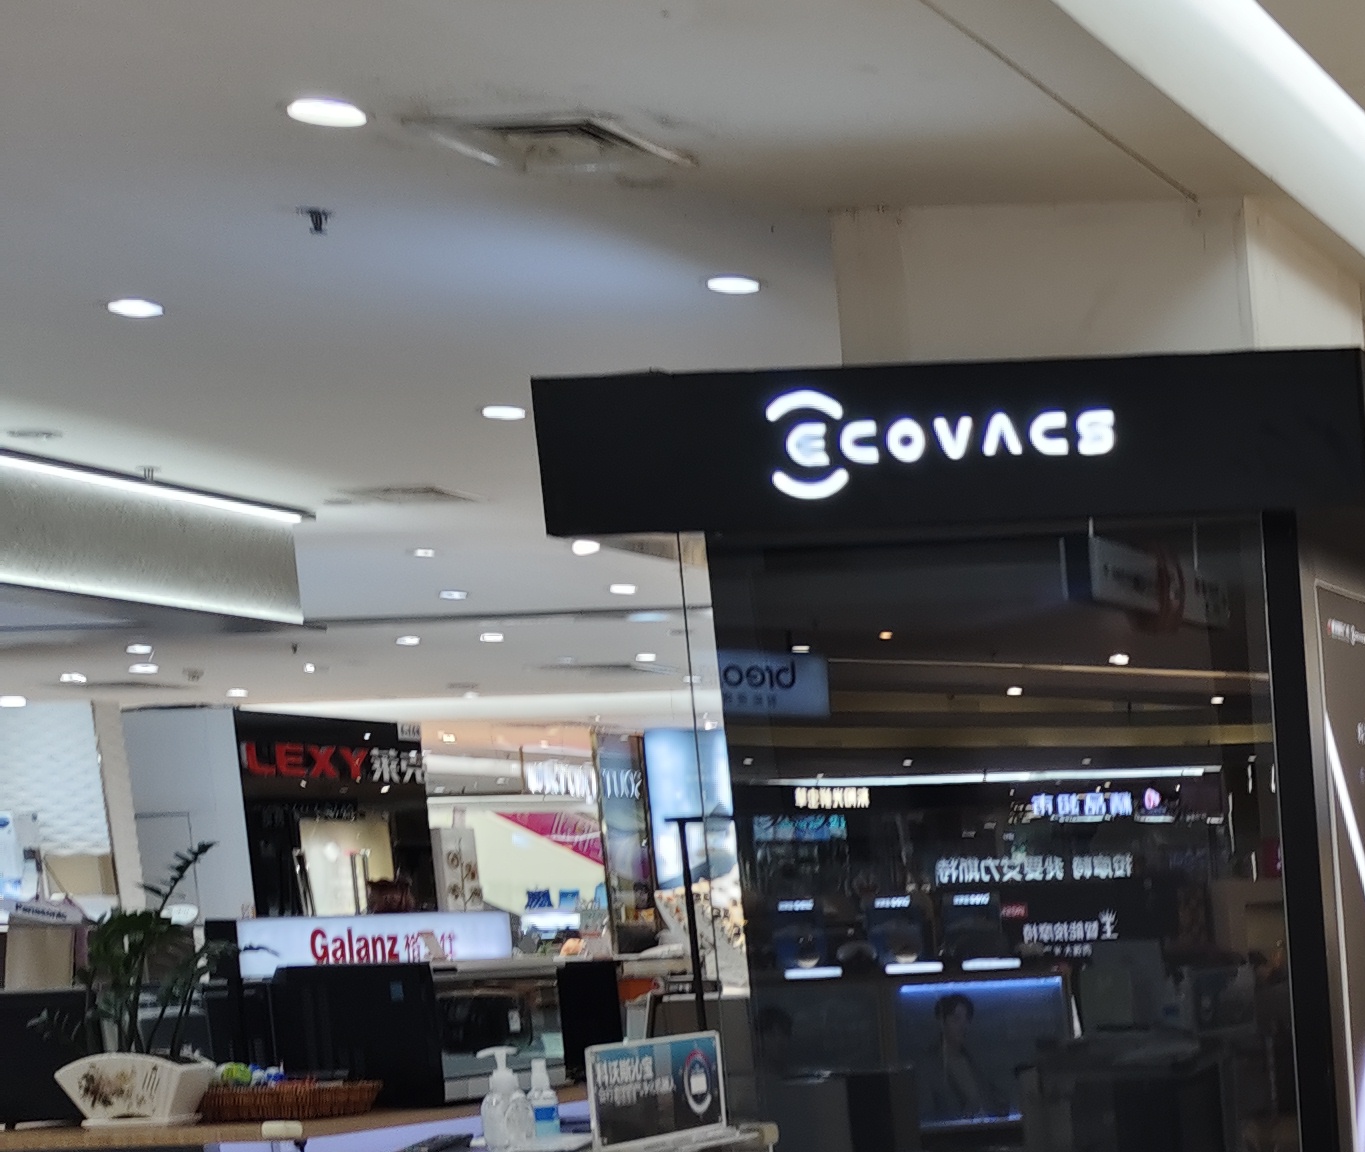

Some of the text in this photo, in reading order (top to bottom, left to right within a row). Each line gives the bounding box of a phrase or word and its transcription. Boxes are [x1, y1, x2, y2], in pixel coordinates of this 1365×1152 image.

[784, 406, 1117, 470] ECOVACS
[242, 742, 369, 780] LEXY
[310, 926, 400, 965] Galanz
